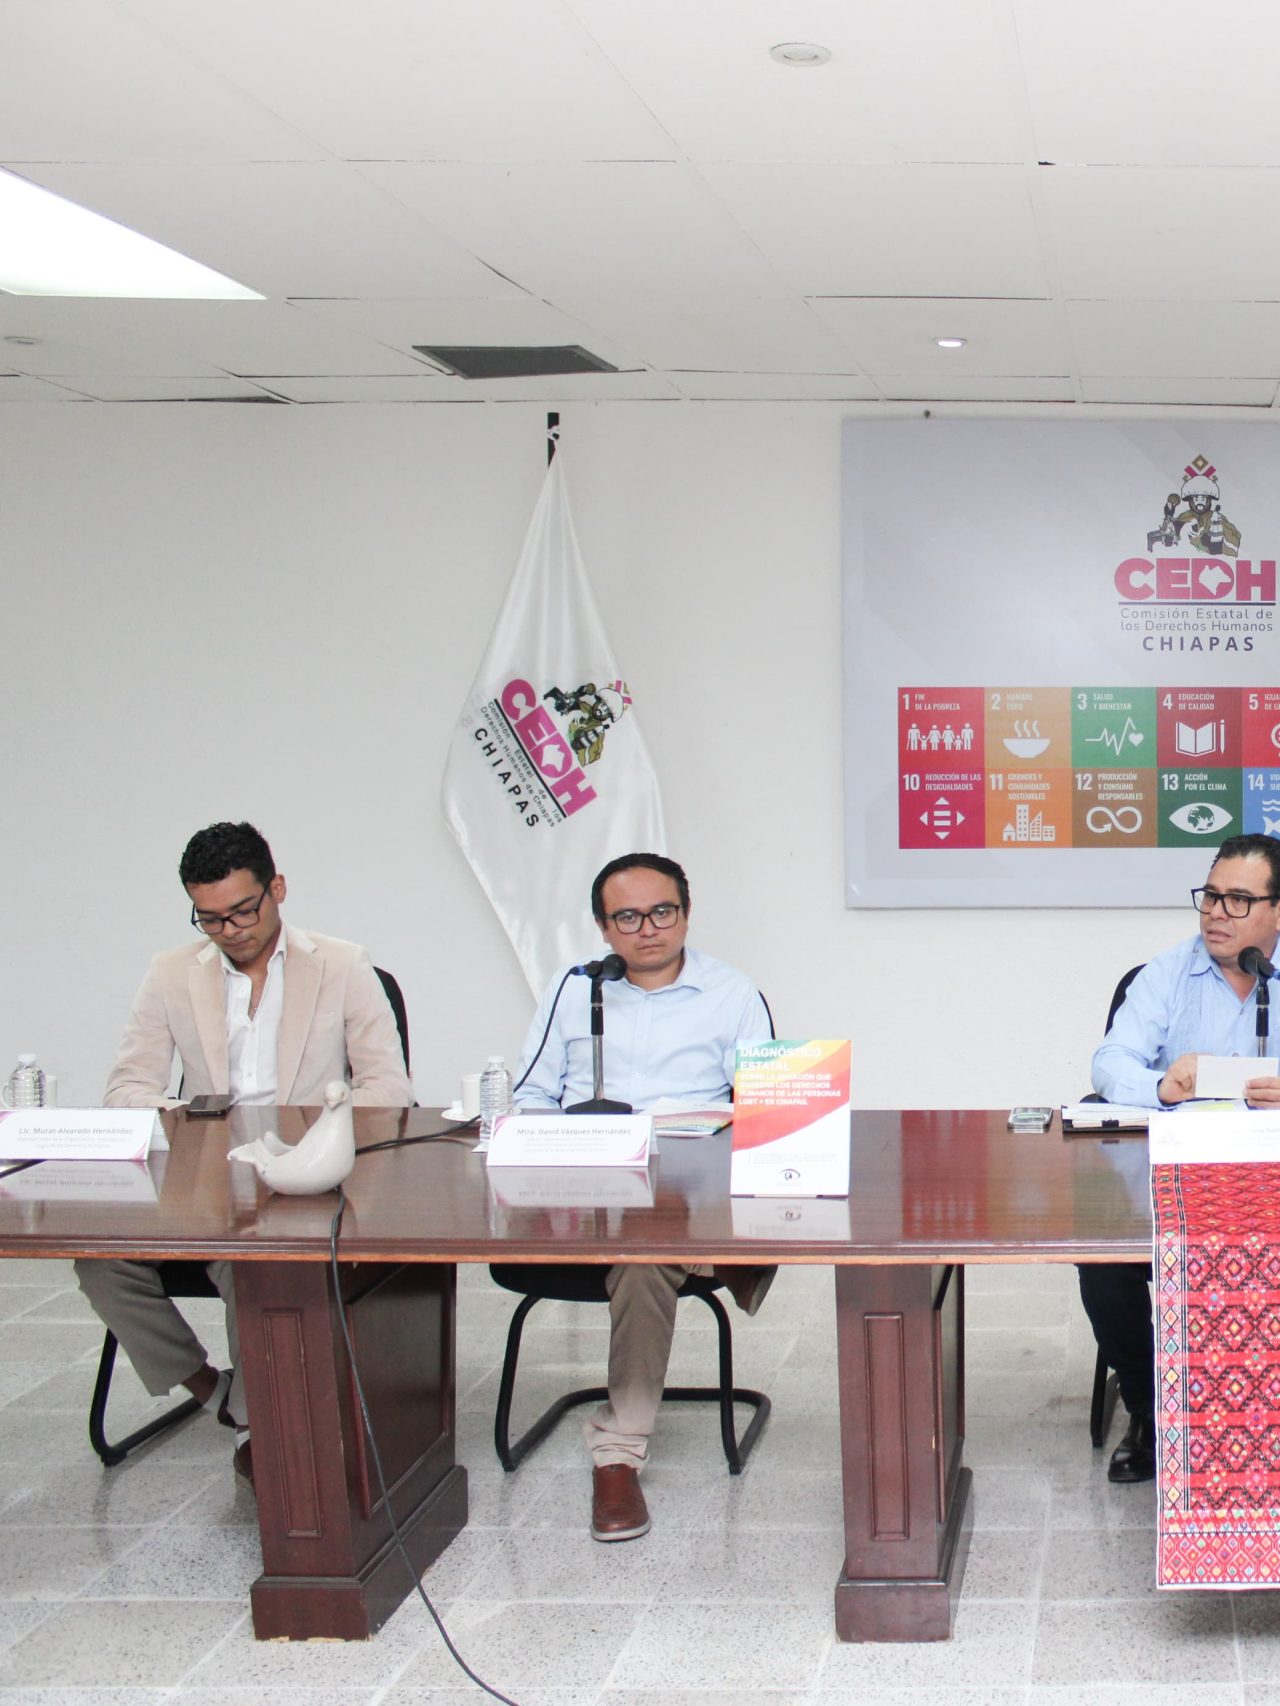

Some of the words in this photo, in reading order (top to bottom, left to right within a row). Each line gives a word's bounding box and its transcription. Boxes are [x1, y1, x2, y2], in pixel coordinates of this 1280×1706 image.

[1114, 558, 1276, 601] CEDH
[1120, 607, 1189, 619] Comisión
[1196, 608, 1249, 619] Estatal
[1256, 609, 1273, 619] de
[1120, 620, 1140, 631] los
[1145, 620, 1206, 631] Derechos
[1212, 620, 1273, 631] Humanos
[1142, 636, 1254, 651] CHIAPAS
[903, 693, 909, 710] 1
[991, 693, 1000, 710] 2
[1078, 693, 1087, 710] 3
[1162, 693, 1173, 710] 4
[1179, 692, 1215, 700] EDUCACIÓN
[1249, 694, 1258, 710] 5
[501, 679, 598, 817] CEDH
[480, 706, 504, 745] Derechos
[503, 745, 527, 783] Humanos
[525, 783, 535, 794] de
[533, 795, 555, 828] Chiapas
[487, 701, 511, 739] Comisión
[515, 749, 534, 778] Estatal
[538, 788, 547, 800] de
[551, 808, 563, 823] los
[474, 727, 540, 827] CHIAPAS
[903, 774, 920, 791] 10
[925, 772, 959, 781] REDUCCIÓN
[961, 773, 969, 781] DE
[970, 773, 981, 781] LAS
[989, 774, 1003, 790] 11
[1075, 773, 1092, 791] 12
[1098, 772, 1137, 781] PRODUCCIÓN
[1162, 774, 1179, 791] 13
[1184, 772, 1208, 781] ACCIÓN
[1248, 774, 1265, 791] 14
[925, 783, 973, 791] DESIGUALDADES
[1097, 783, 1102, 791] Y
[1103, 783, 1134, 791] CONSUMO
[1184, 783, 1198, 791] POR
[1199, 783, 1206, 791] EL
[1207, 783, 1227, 791] CLIMA
[1098, 792, 1143, 800] RESPONSABLES
[740, 1046, 822, 1058] DIAGNÓSTICO
[33, 1127, 57, 1135] Murat
[57, 1127, 91, 1135] Alvarado
[92, 1127, 133, 1135] Hernández
